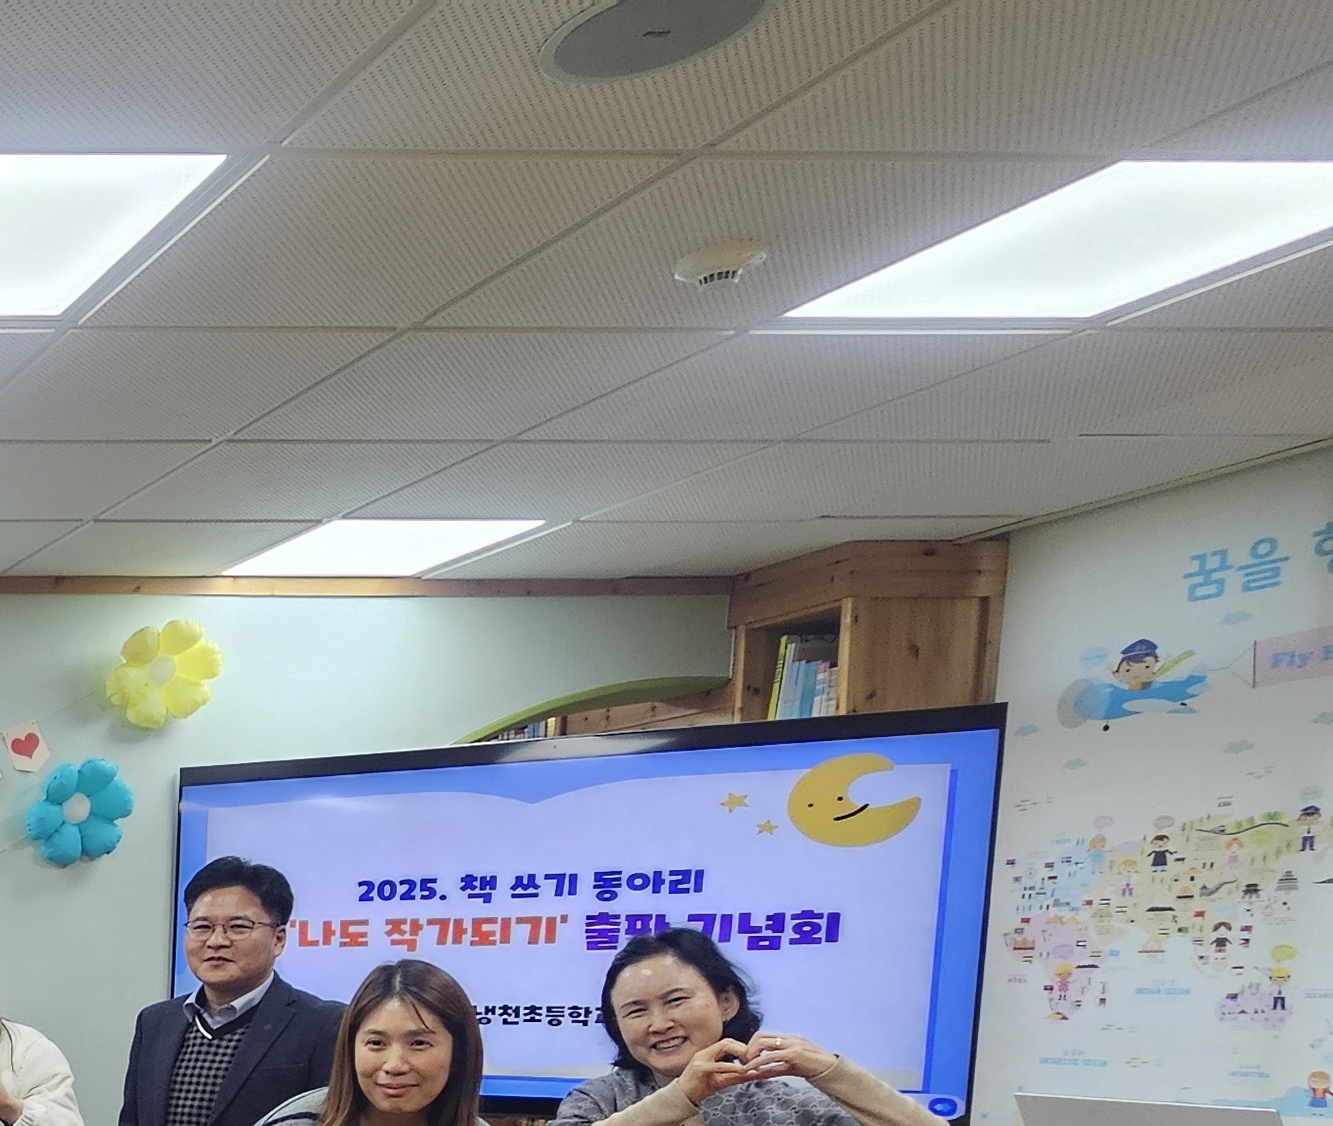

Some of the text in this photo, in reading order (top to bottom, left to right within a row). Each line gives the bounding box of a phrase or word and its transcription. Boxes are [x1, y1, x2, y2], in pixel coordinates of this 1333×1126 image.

[1182, 536, 1290, 602] 꿈을
[357, 868, 705, 904] 2025. 책 쓰기 동아리
[384, 913, 569, 952] 작가되기'
[686, 909, 841, 951] 기념회
